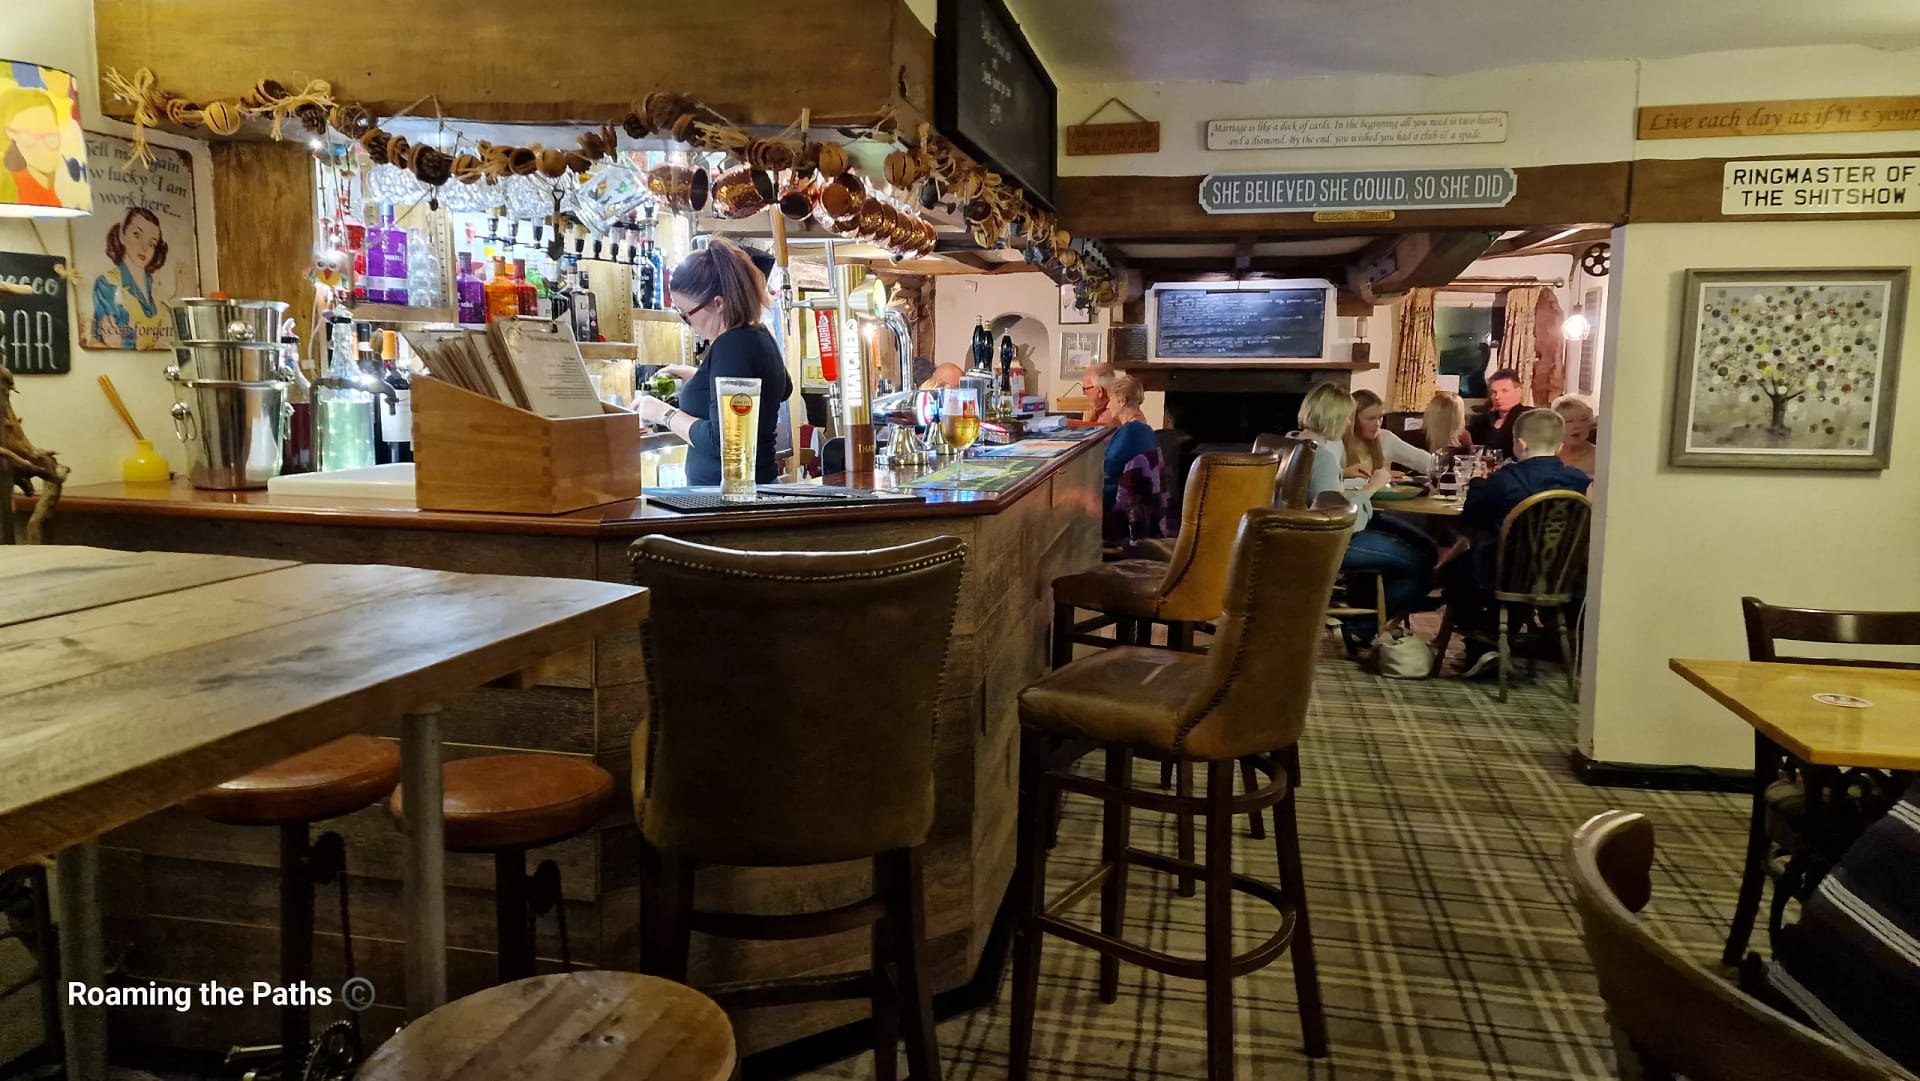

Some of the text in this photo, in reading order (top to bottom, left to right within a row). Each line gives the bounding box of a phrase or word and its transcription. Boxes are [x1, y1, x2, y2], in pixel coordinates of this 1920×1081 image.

[1214, 124, 1247, 134] Marriage
[1257, 120, 1271, 133] like
[1279, 119, 1298, 132] deck
[1298, 120, 1309, 134] of
[1334, 119, 1344, 129] In
[1345, 118, 1358, 129] the
[1360, 118, 1399, 130] beginning
[1400, 116, 1413, 127] all
[1412, 120, 1428, 130] you
[1429, 117, 1449, 127] need
[1650, 112, 1693, 131] Live
[1698, 108, 1742, 129] each
[1746, 107, 1783, 131] day
[1787, 110, 1810, 125] as
[1815, 103, 1838, 130] if
[1228, 136, 1245, 145] and
[1289, 135, 1300, 146] By
[1301, 134, 1314, 145] the
[1334, 135, 1350, 146] you
[1350, 131, 1380, 143] wished
[1379, 134, 1395, 144] you
[1395, 130, 1412, 141] had
[108, 166, 148, 192] lucky
[166, 185, 188, 199] am
[1733, 165, 1917, 185] RINGMASTER OF
[100, 191, 135, 204] work
[1212, 174, 1504, 204] SHE BELIEVED SHE COULD, SO SHE DID
[1741, 187, 1907, 207] THE SHITSHOW
[134, 320, 175, 343] forgett
